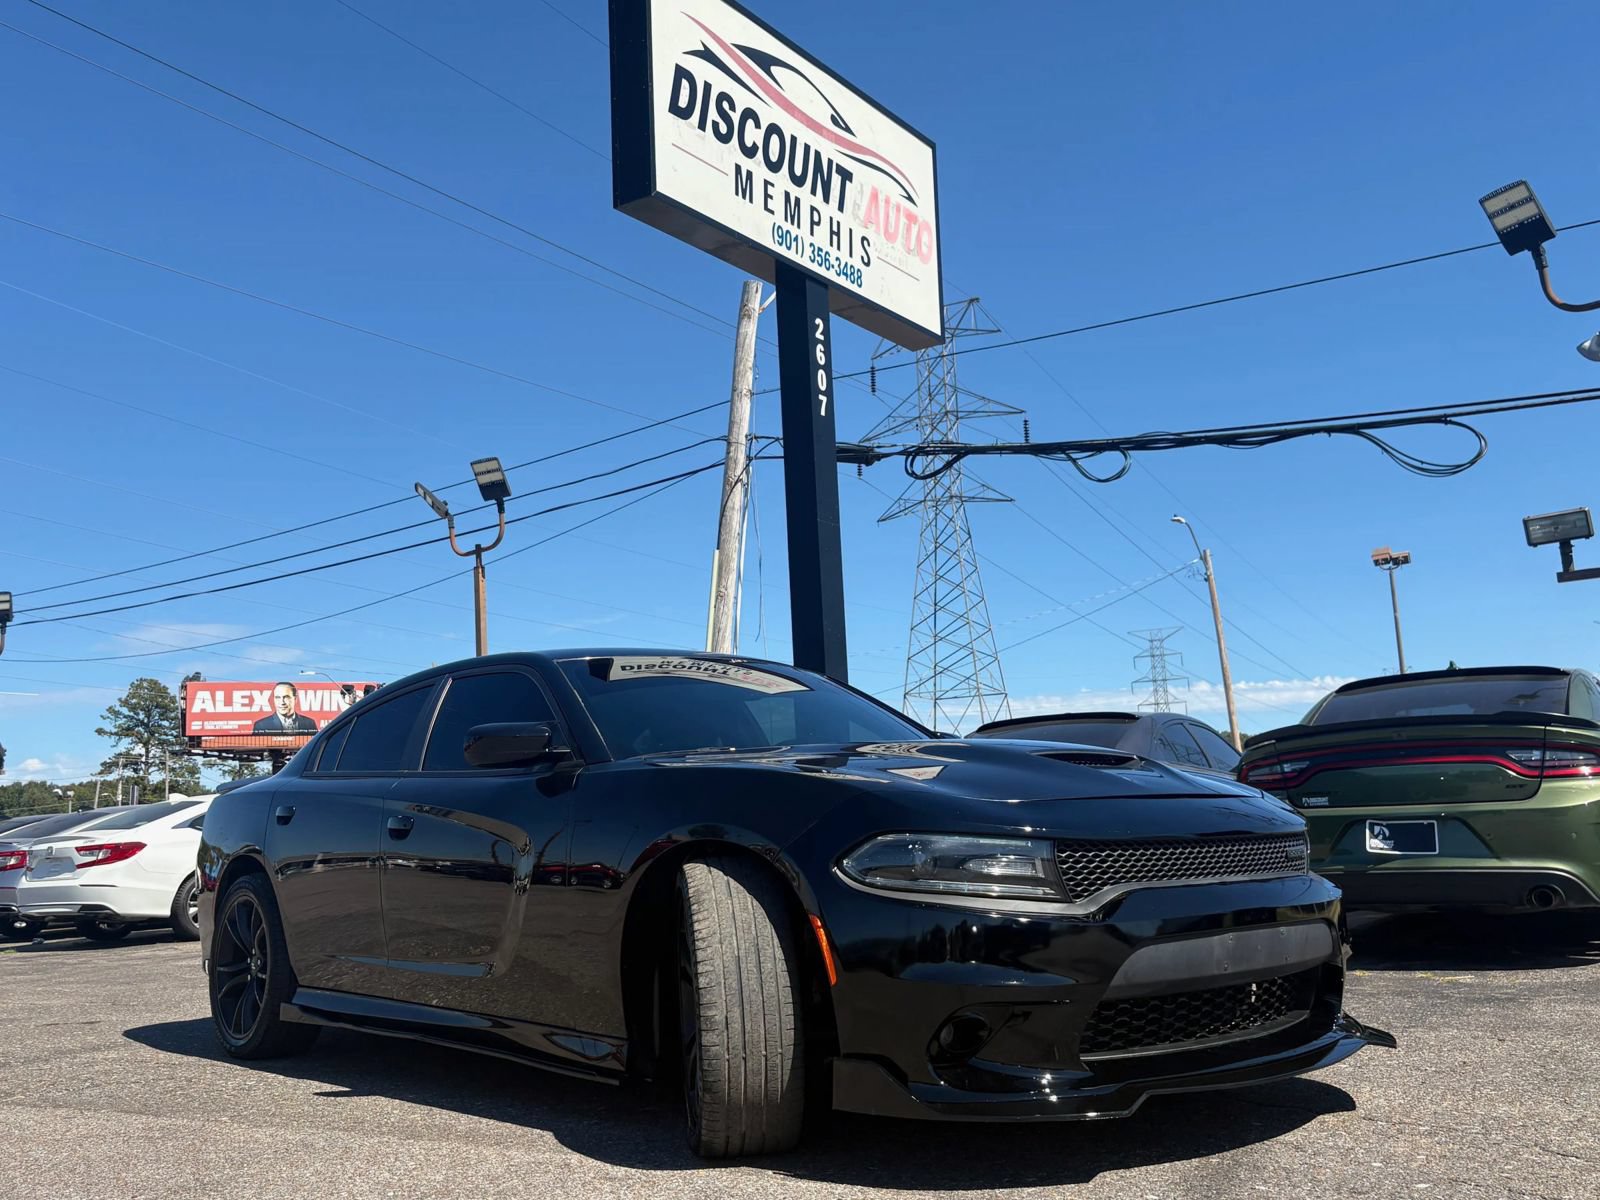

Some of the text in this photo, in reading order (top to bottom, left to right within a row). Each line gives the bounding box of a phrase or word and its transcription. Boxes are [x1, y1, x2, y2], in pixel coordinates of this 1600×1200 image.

[668, 63, 933, 265] DISCOUNT AUTO
[734, 162, 871, 267] MEMPHIS
[772, 222, 863, 288] (901) 356-3488
[814, 317, 827, 416] 2607
[191, 690, 272, 713] ALEX
